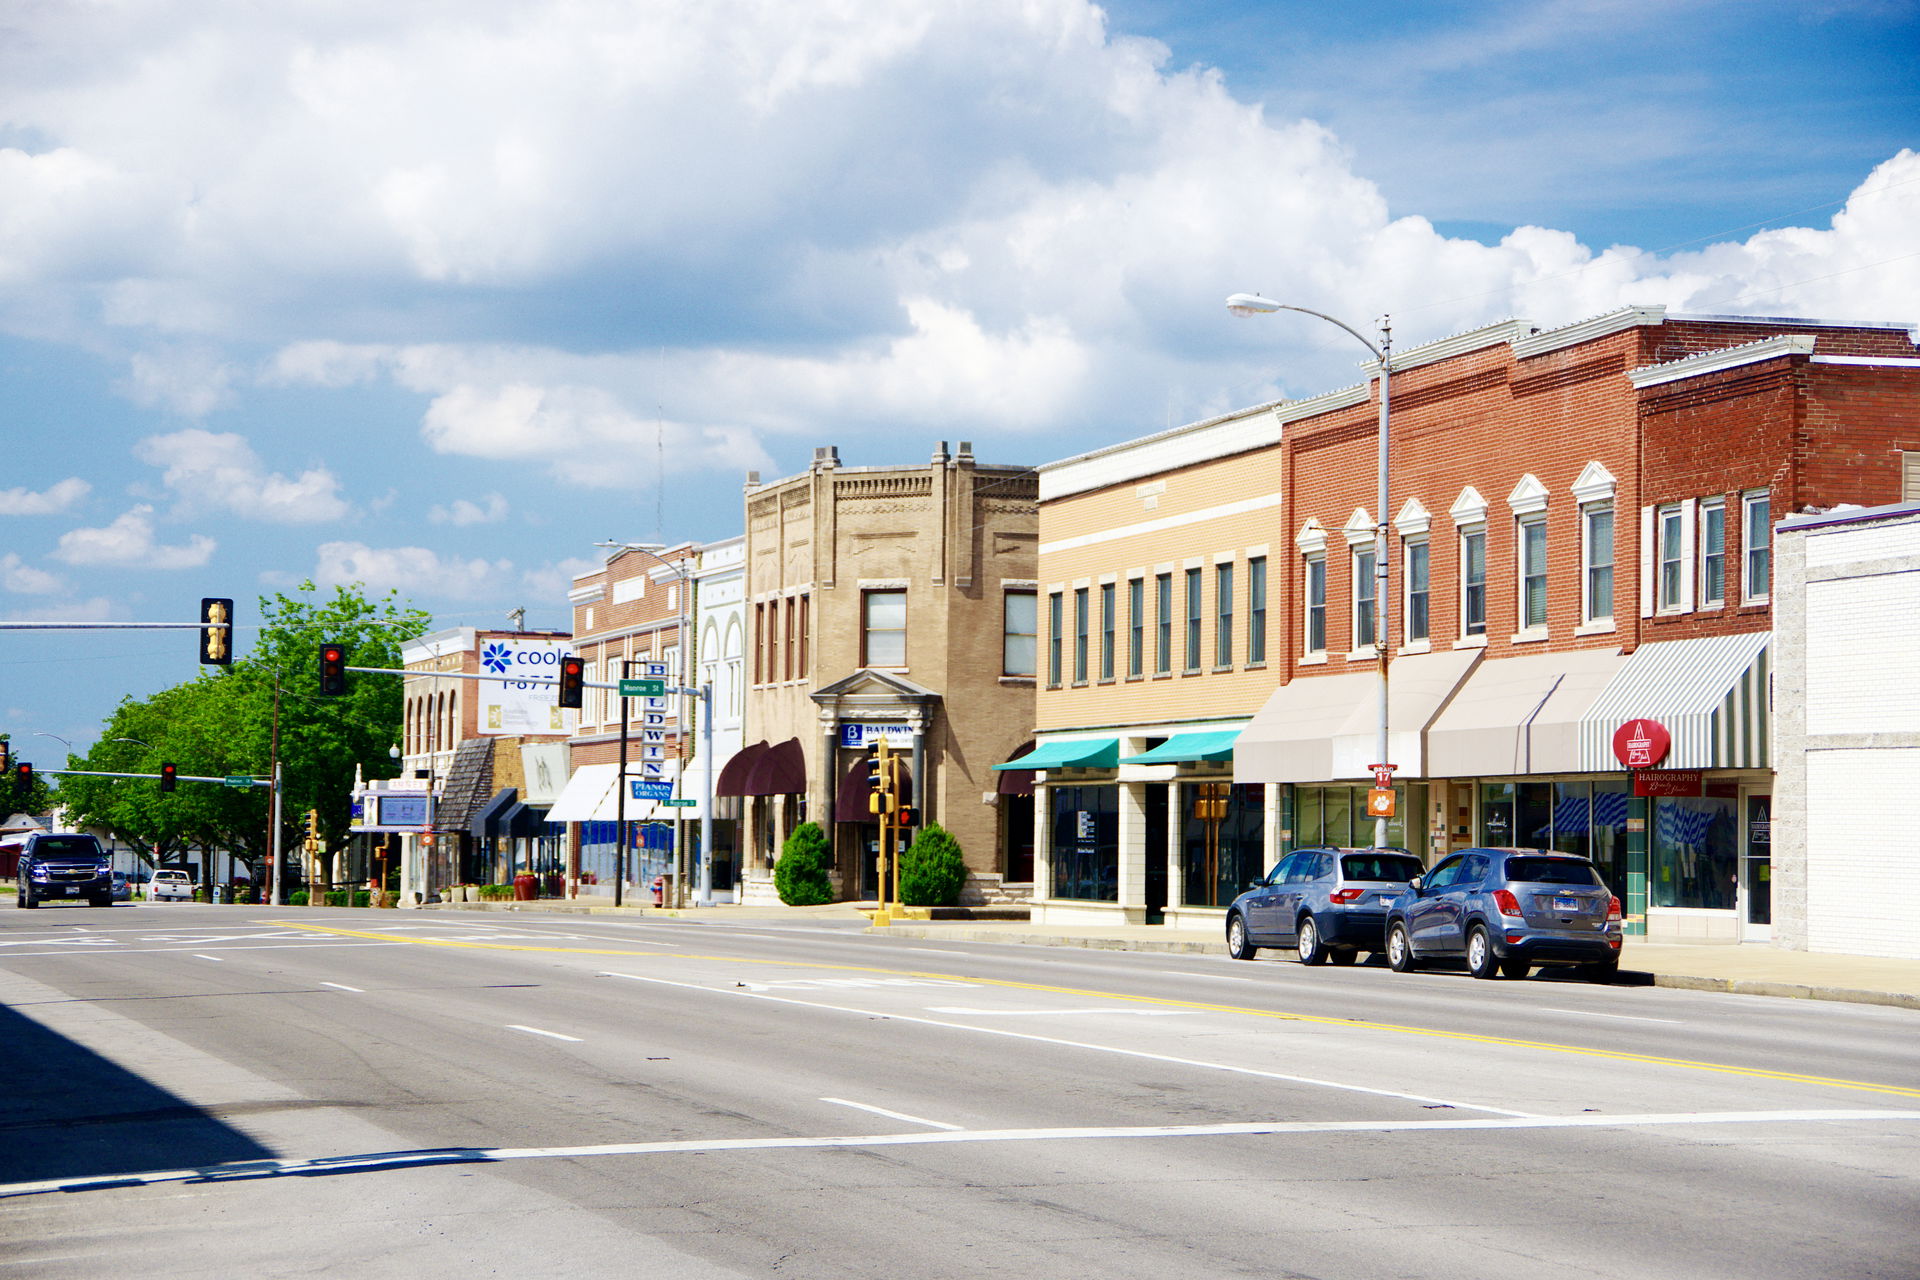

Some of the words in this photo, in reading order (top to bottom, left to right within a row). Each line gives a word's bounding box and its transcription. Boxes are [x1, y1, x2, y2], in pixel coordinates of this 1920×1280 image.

[623, 684, 647, 692] Monroe
[652, 684, 660, 692] St
[866, 726, 914, 734] BALDWIN
[1377, 773, 1390, 782] 17
[1639, 773, 1698, 782] HAIROGRAPHY
[635, 782, 671, 791] PIANOS
[635, 790, 670, 798] ORGANS
